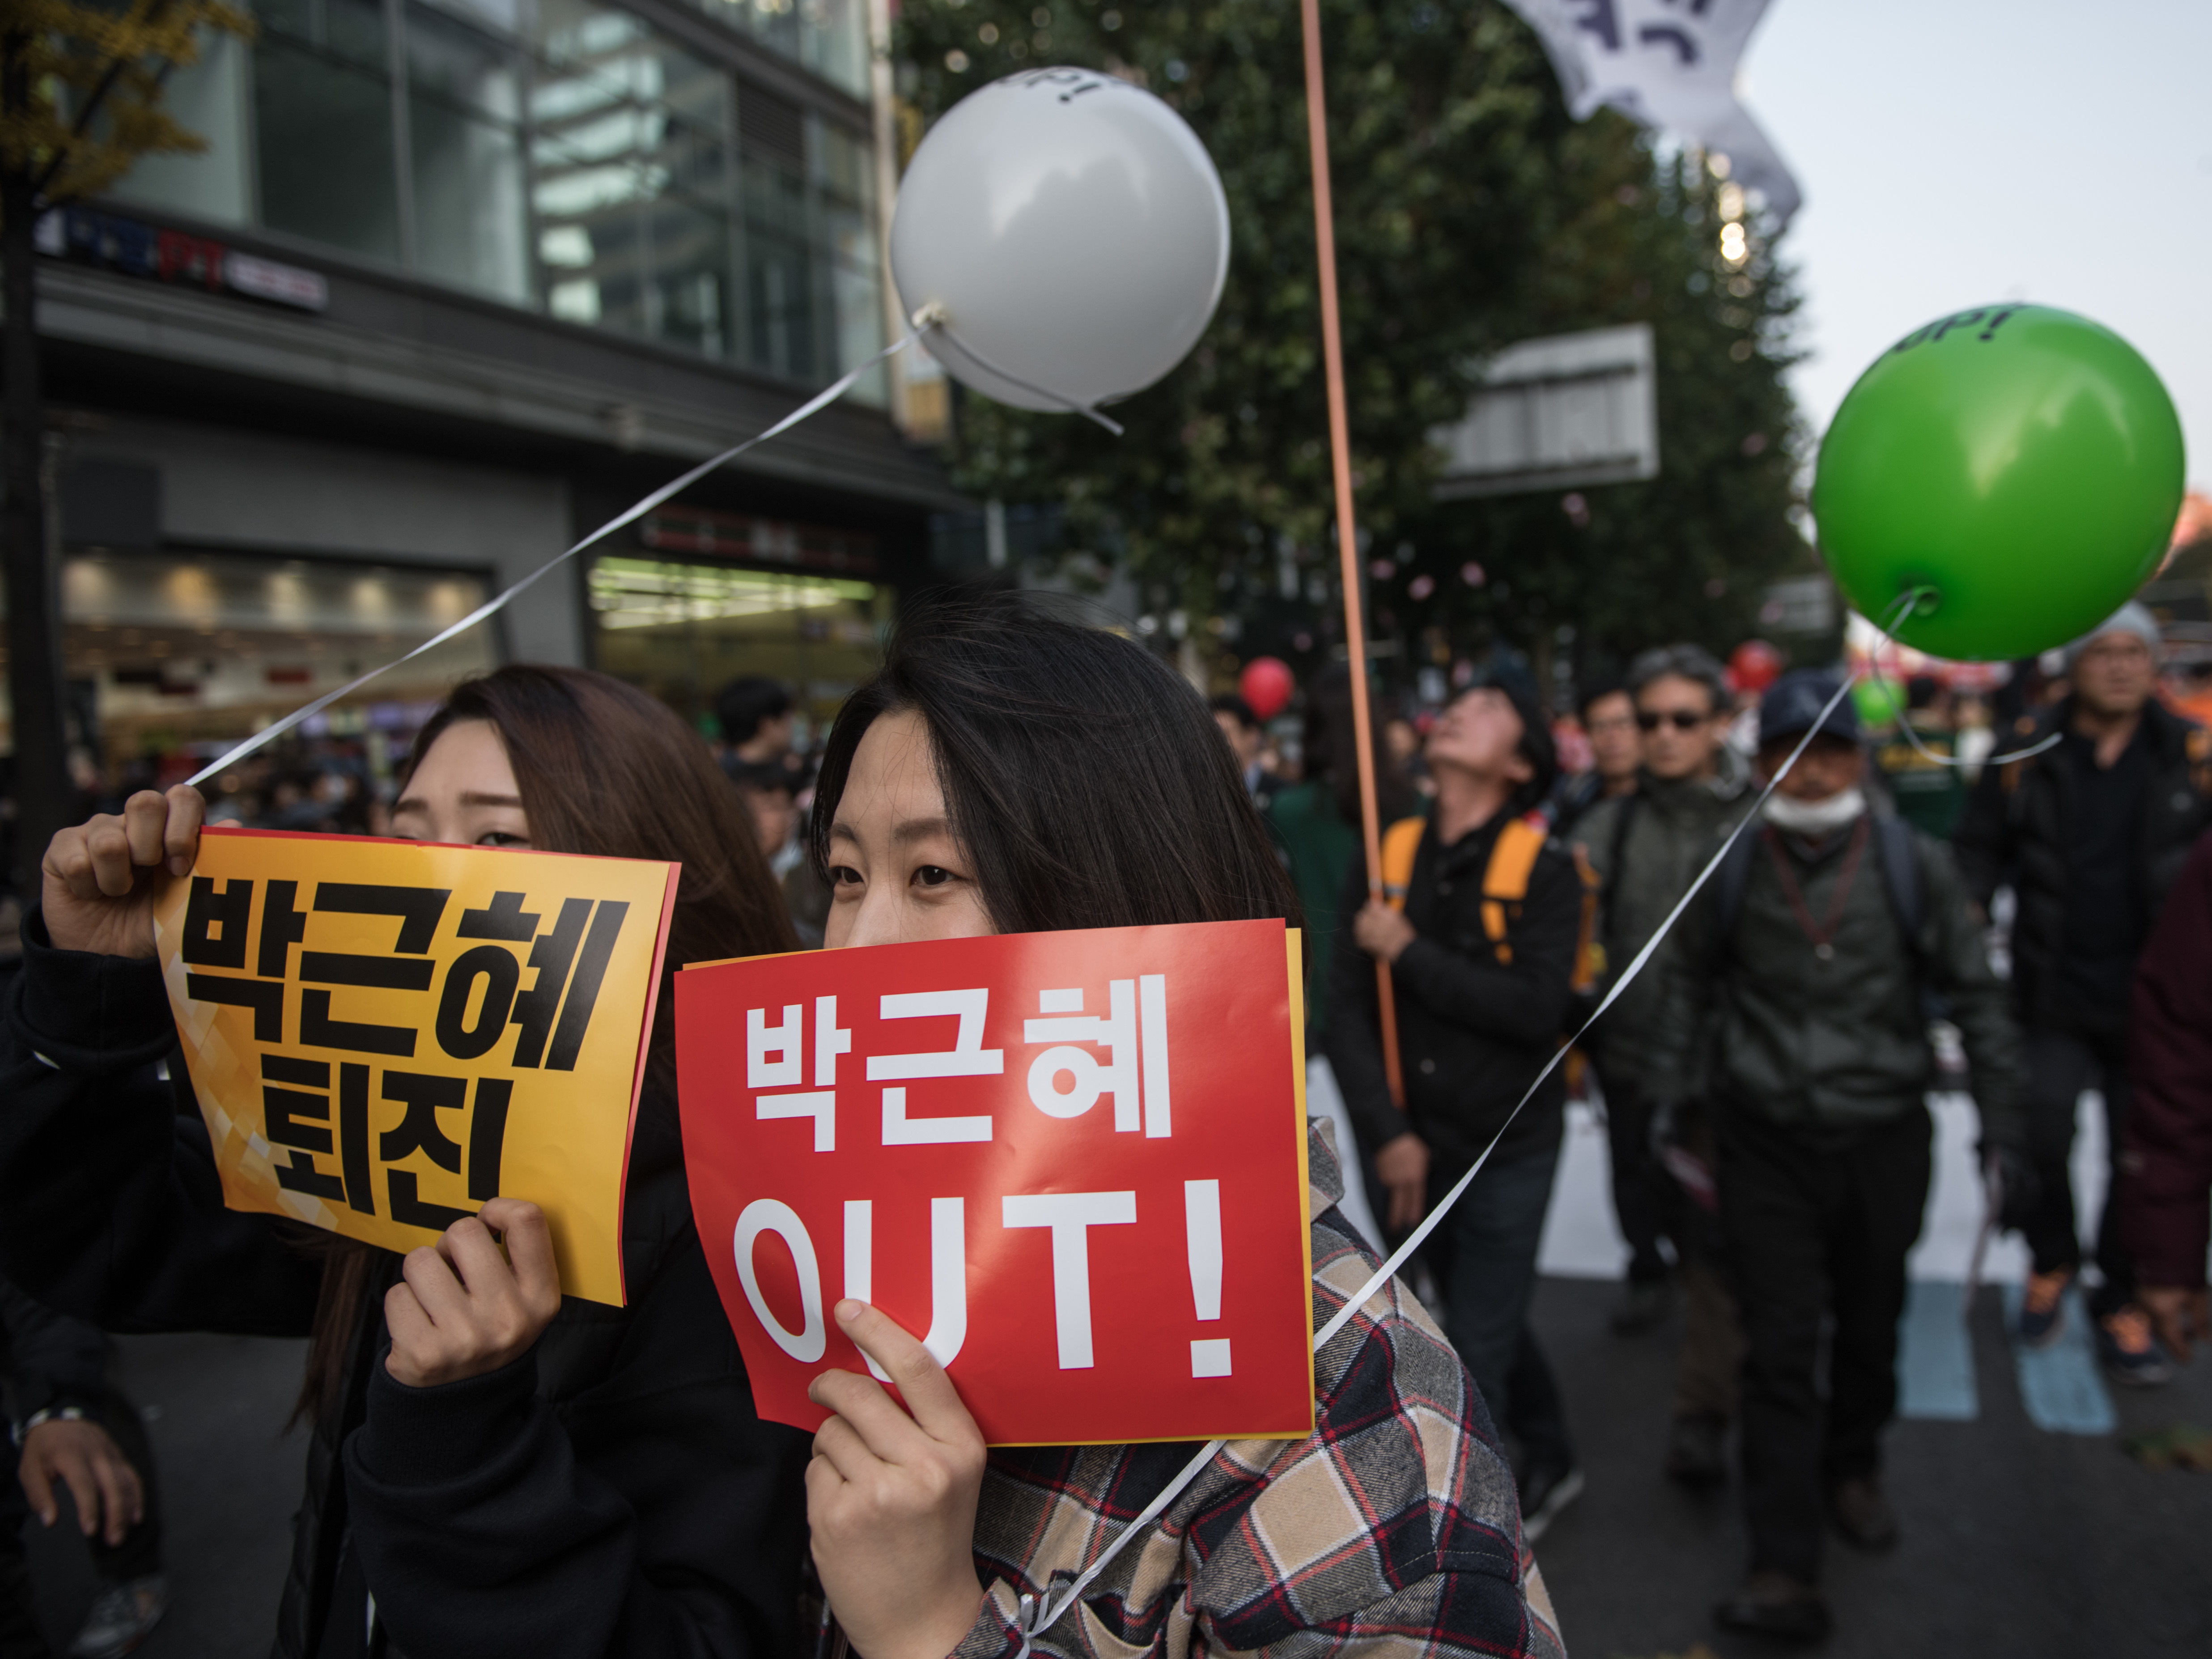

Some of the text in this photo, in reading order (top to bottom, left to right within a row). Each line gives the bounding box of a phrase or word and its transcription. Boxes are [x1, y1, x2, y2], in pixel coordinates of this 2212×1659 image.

[182, 876, 631, 1072] 박근혜
[747, 974, 1172, 1153] 박근혜
[260, 1053, 514, 1244] 퇴진
[734, 1179, 1232, 1383] OUT!
